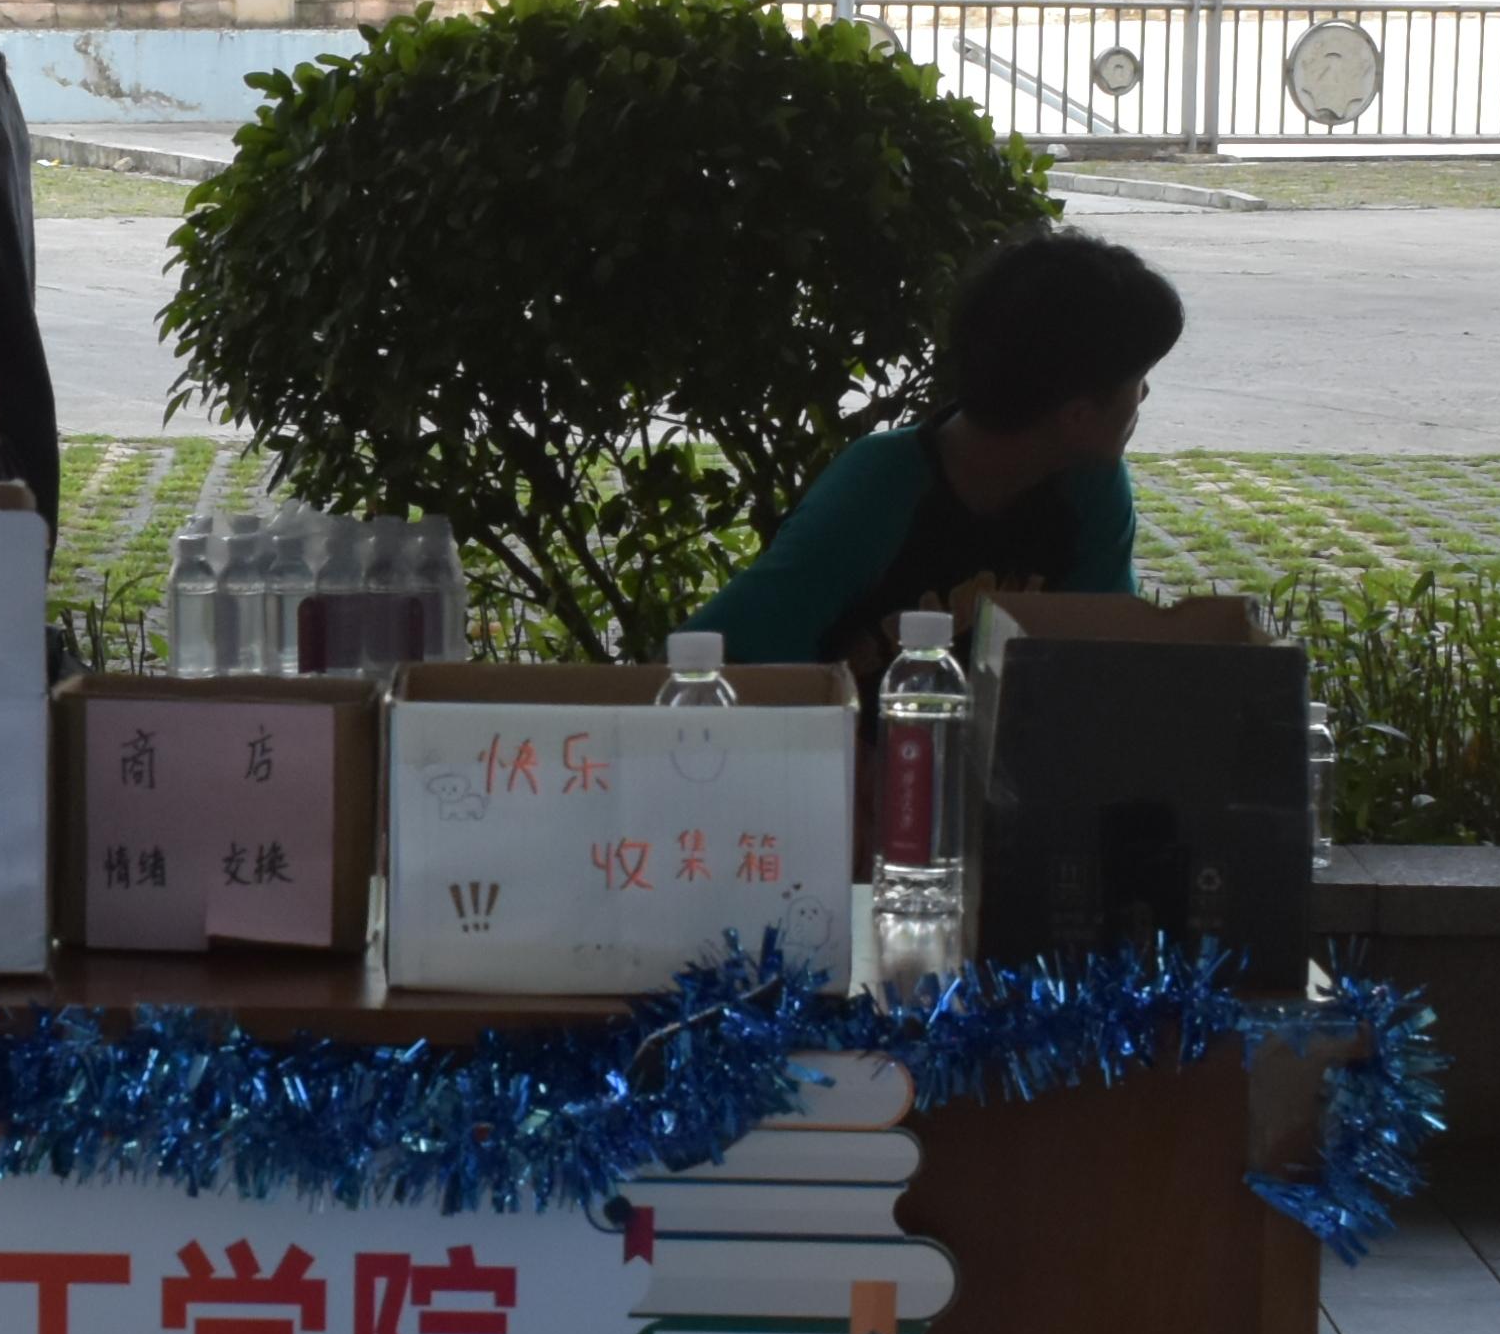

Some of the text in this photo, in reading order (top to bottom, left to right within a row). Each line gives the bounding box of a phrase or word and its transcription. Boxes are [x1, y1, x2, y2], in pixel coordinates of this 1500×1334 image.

[120, 725, 274, 789] 商店
[476, 731, 610, 795] 快乐
[590, 829, 783, 891] 收集箱
